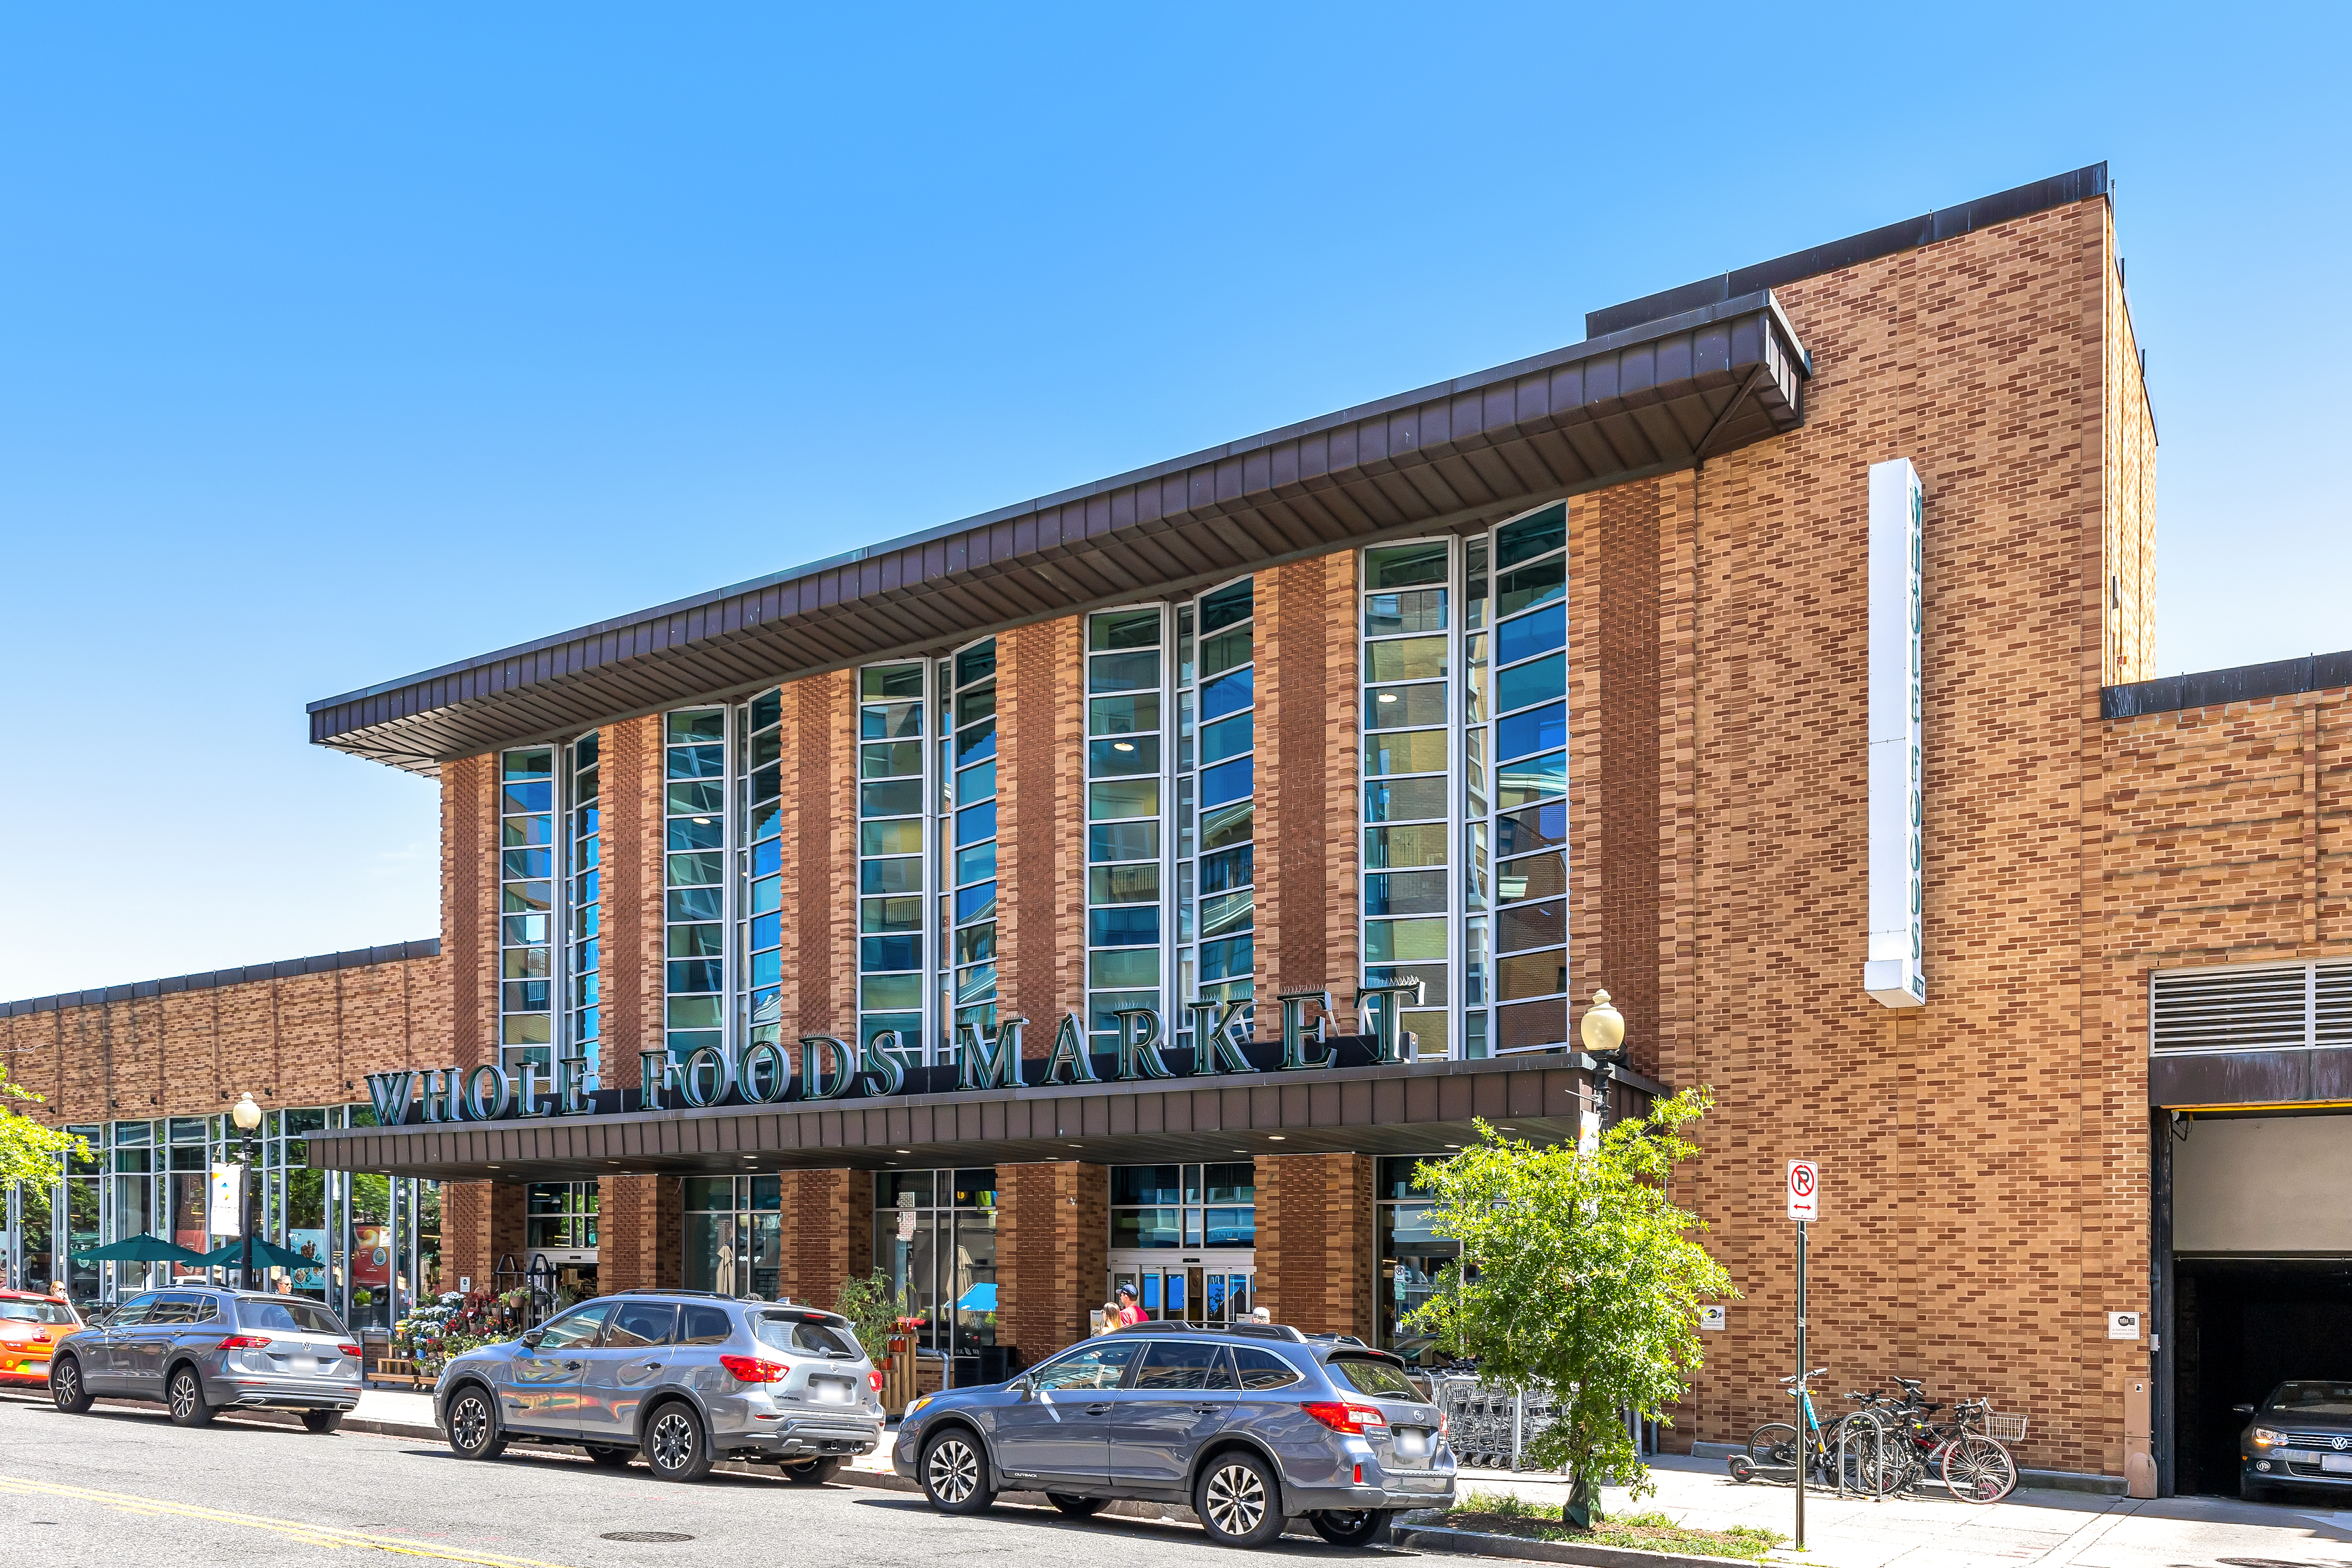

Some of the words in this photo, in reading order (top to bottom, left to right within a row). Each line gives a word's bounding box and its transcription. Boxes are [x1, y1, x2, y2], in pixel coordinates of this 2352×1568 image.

[1909, 483, 1922, 724] WHOLE
[1910, 742, 1920, 959] FOODS
[363, 1056, 594, 1127] WHOLE
[637, 1030, 904, 1111] FOODS
[955, 980, 1425, 1091] MARKET
